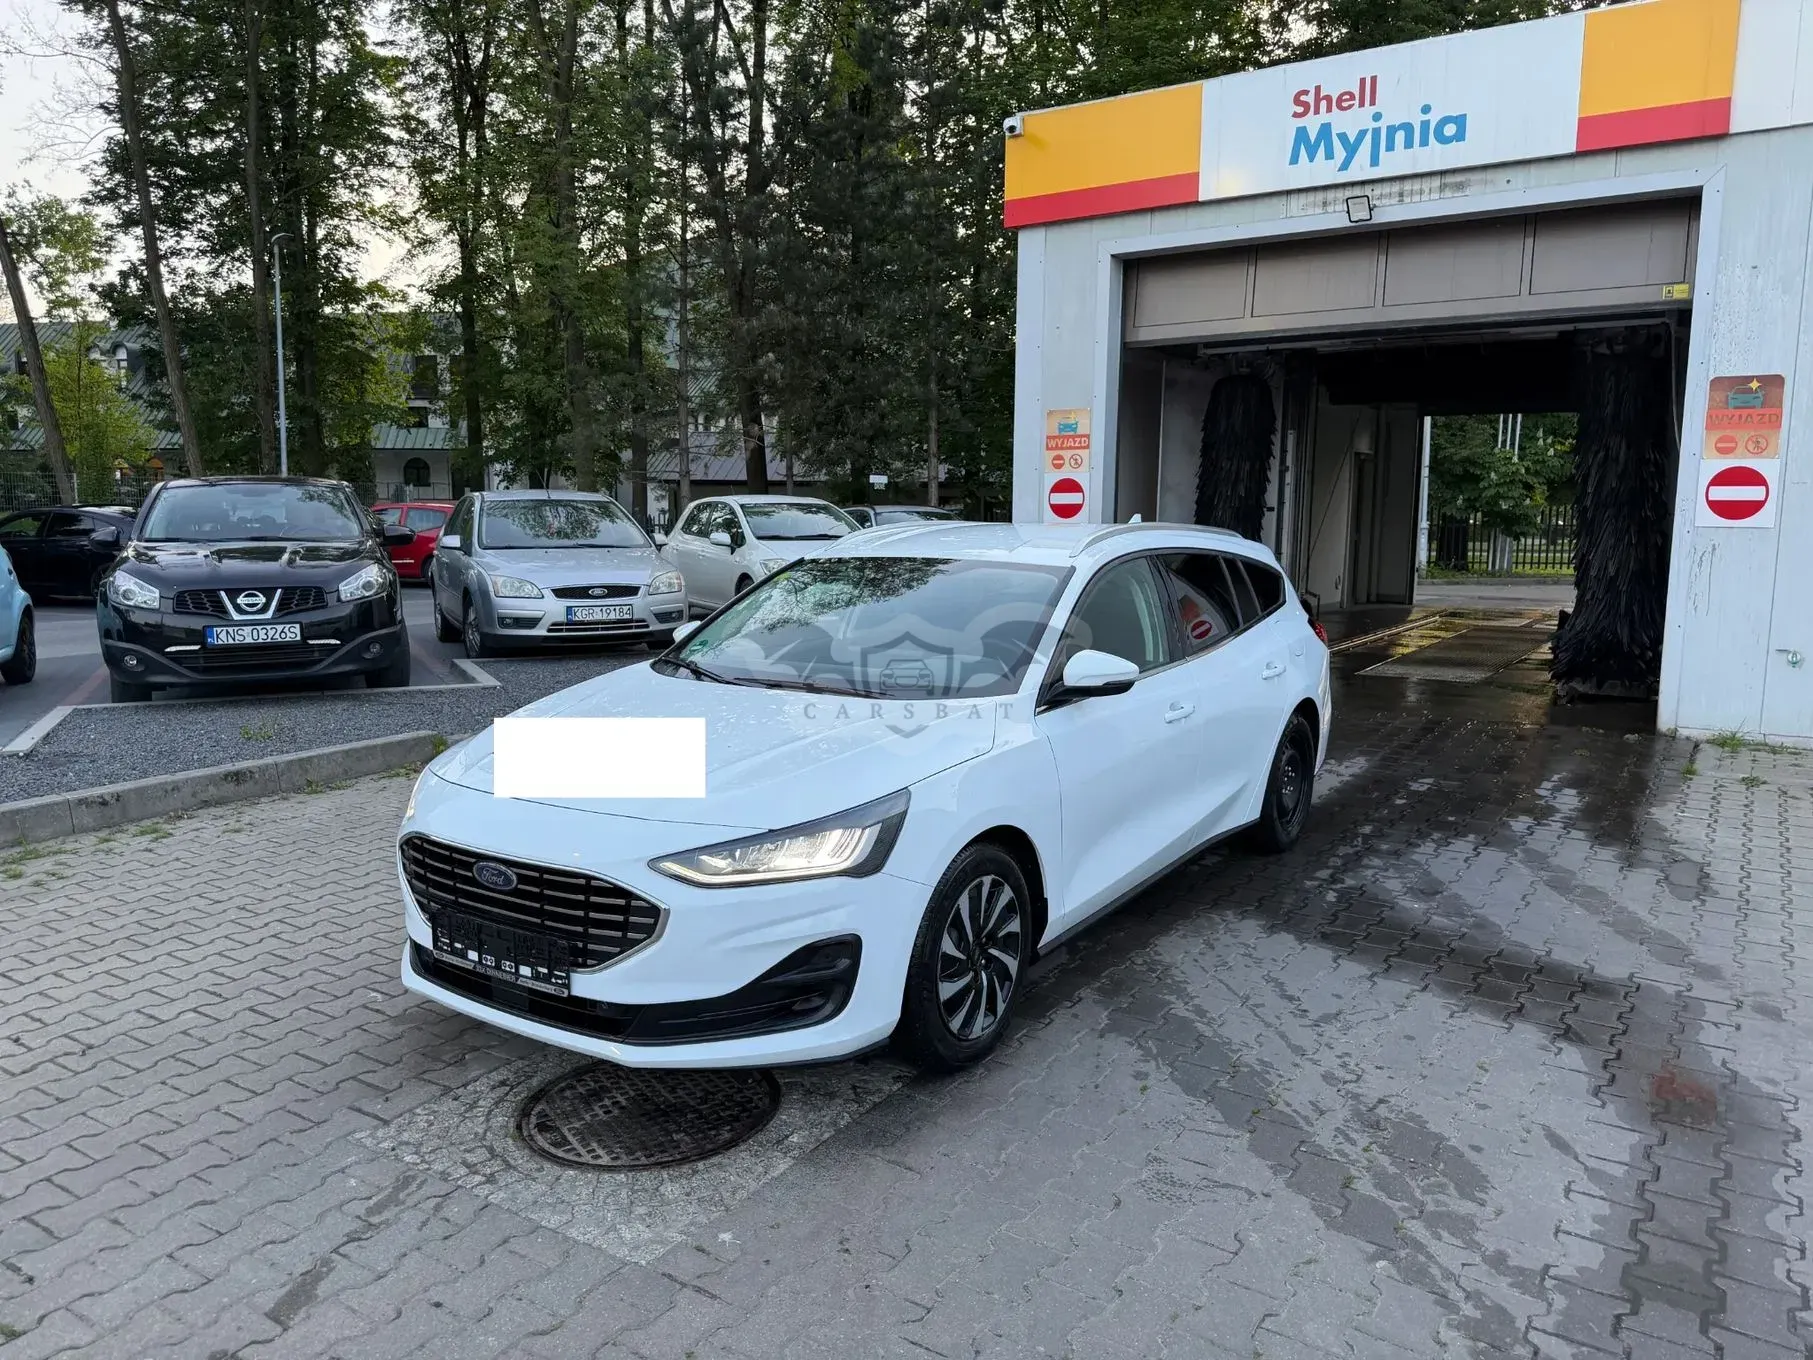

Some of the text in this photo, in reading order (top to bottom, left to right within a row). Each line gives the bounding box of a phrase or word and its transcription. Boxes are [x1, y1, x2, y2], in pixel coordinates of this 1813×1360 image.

[1291, 75, 1378, 119] Shell
[1288, 104, 1467, 172] Myjnia
[1709, 413, 1780, 425] WYJAZD
[1047, 437, 1089, 448] WYJAZD
[573, 607, 631, 619] KGR 19184
[215, 626, 298, 643] KNS 0326S
[482, 867, 504, 885] Ford
